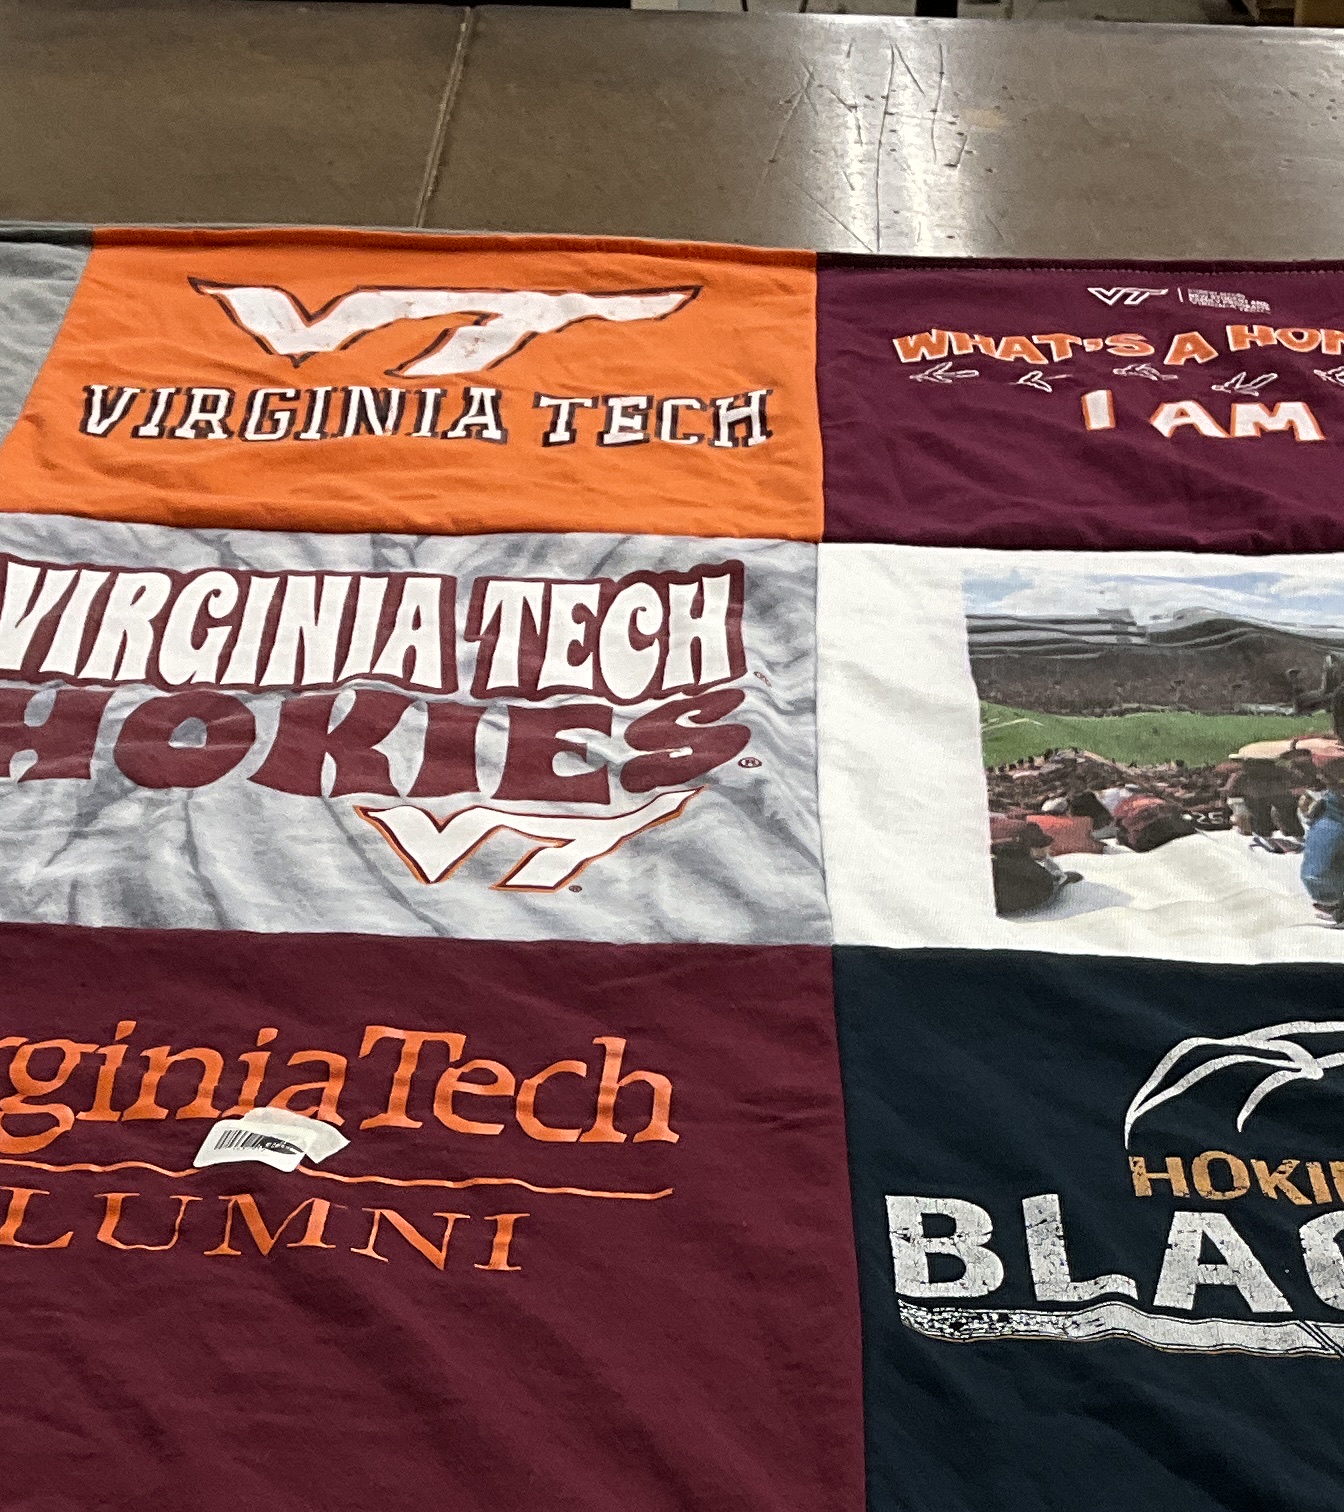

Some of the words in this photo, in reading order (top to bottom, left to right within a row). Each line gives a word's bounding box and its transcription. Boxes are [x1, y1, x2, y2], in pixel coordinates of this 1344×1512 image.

[187, 276, 702, 378] VT
[1087, 287, 1169, 306] VT
[893, 328, 1155, 365] WHAT'S
[1163, 331, 1220, 366] A
[80, 384, 508, 444] VIRGINIA
[535, 388, 775, 448] TECH
[1081, 388, 1116, 431] I
[1150, 399, 1326, 442] AM
[470, 559, 745, 703] TECH
[354, 786, 705, 893] VT
